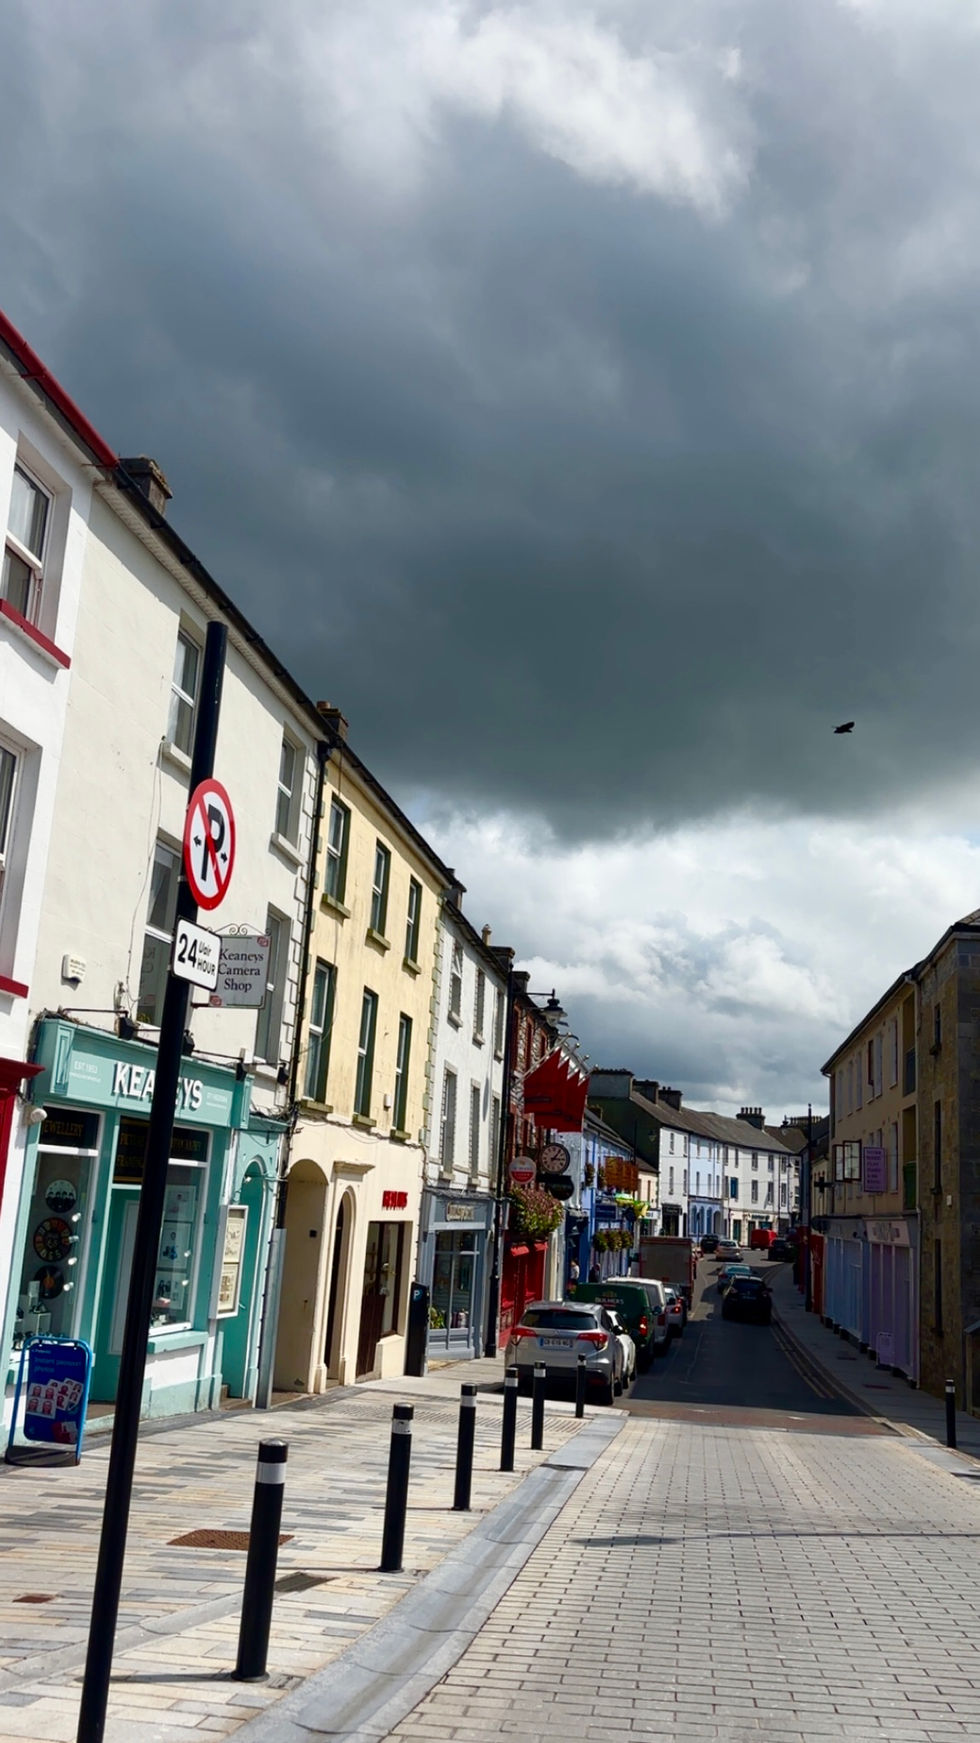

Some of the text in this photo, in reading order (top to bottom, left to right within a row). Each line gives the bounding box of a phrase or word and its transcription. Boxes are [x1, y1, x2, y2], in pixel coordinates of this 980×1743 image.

[177, 932, 197, 968] 24
[198, 940, 212, 957] Uair
[219, 948, 264, 963] Keaneys
[196, 957, 216, 977] HOUR
[218, 963, 261, 976] Camera
[223, 977, 253, 993] Shop
[110, 1060, 204, 1111] KEAYS
